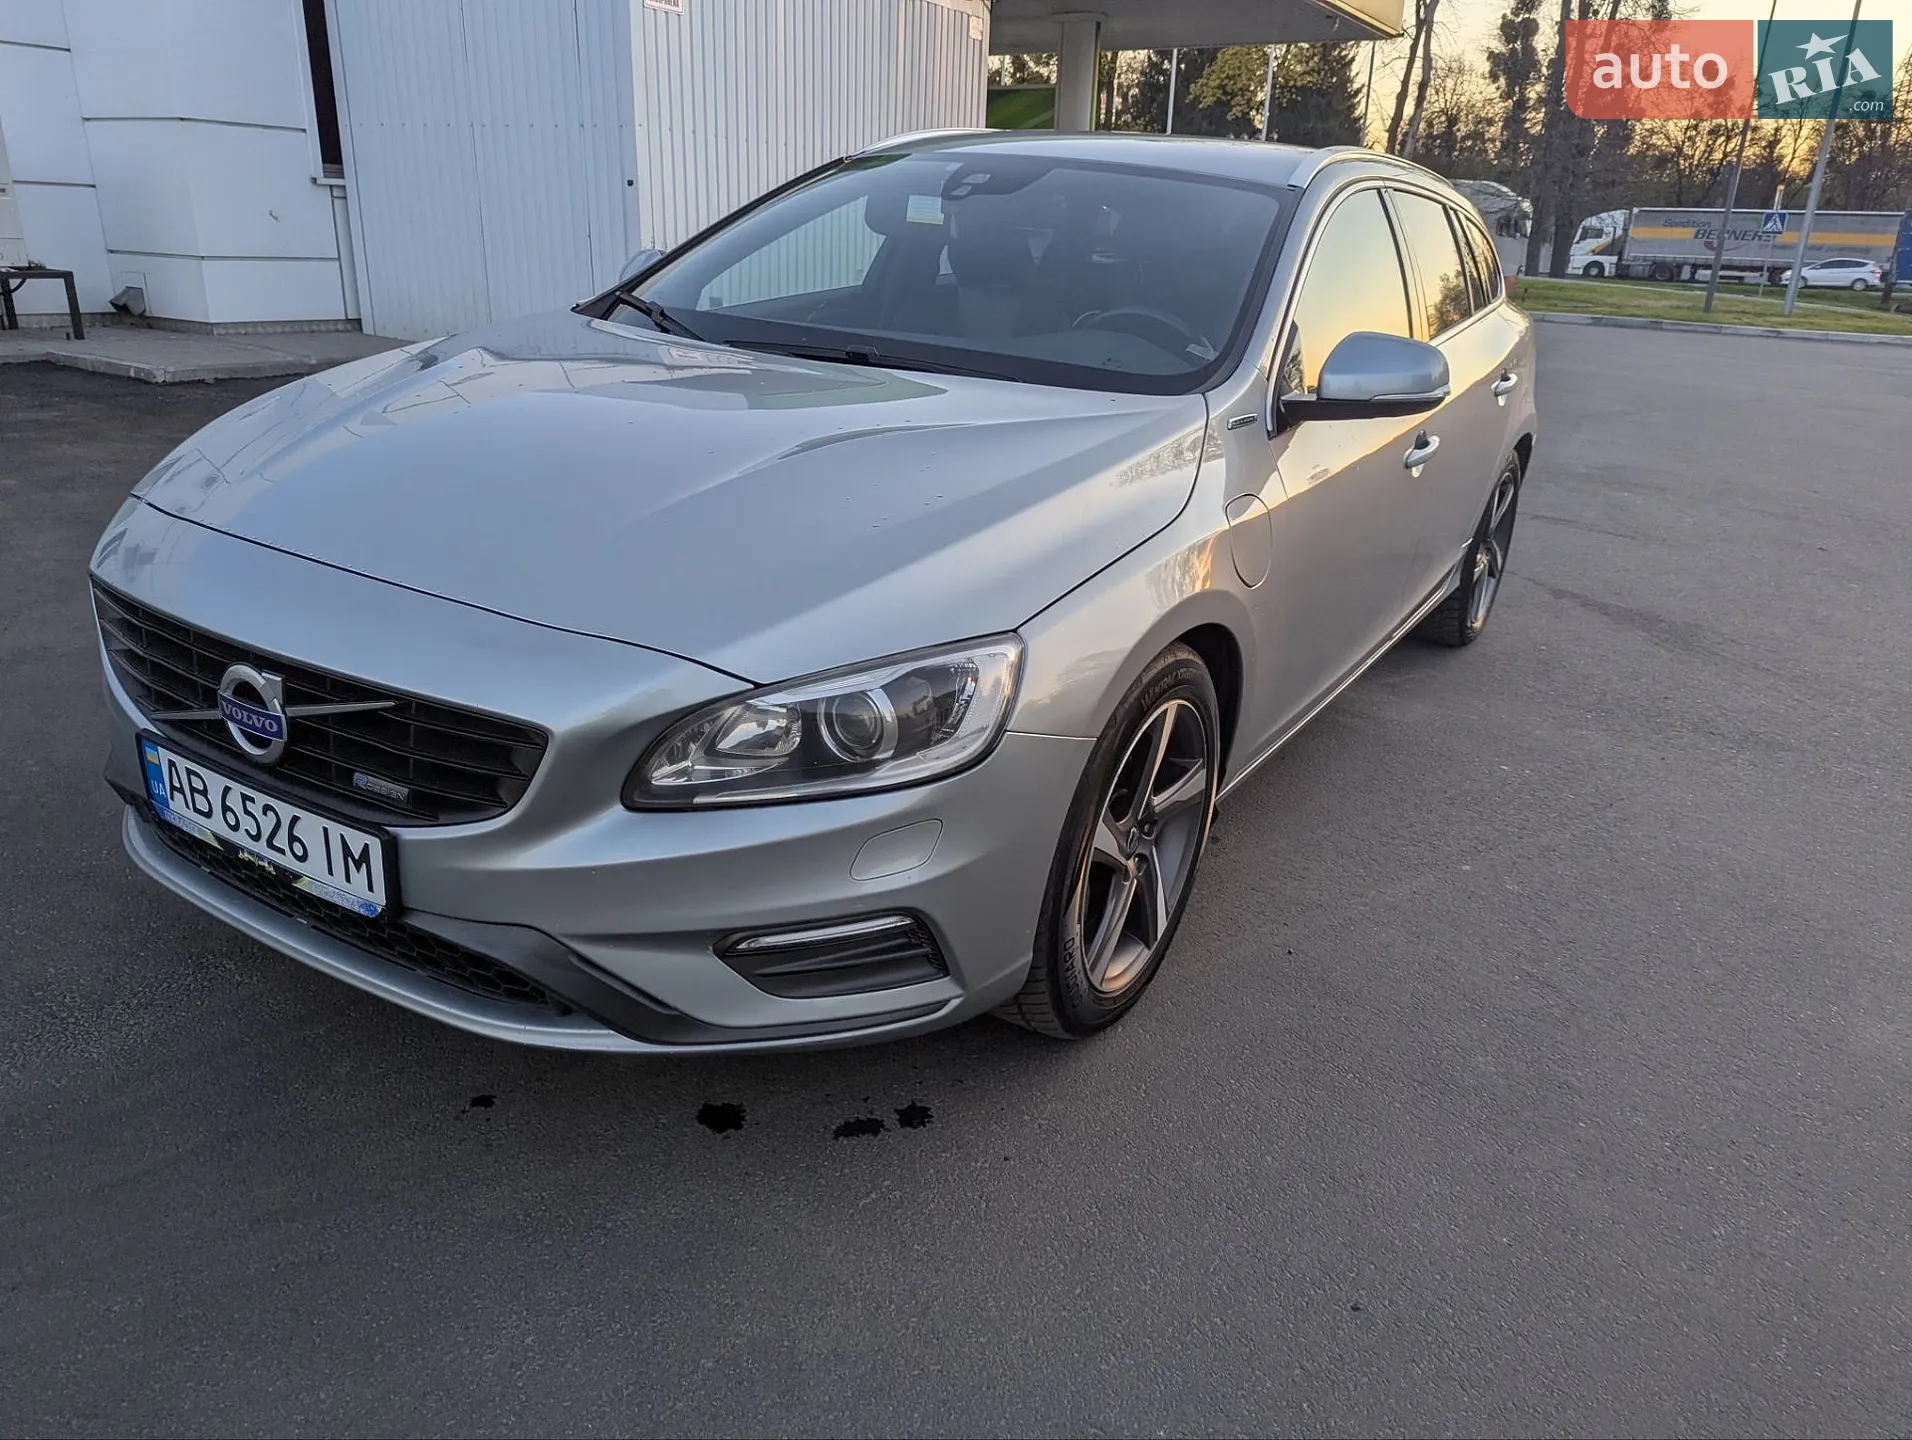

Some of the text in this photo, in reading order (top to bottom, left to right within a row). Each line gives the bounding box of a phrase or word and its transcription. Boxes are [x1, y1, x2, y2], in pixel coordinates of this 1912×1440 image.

[221, 701, 279, 732] VOLVO
[150, 780, 167, 799] UA
[167, 758, 375, 893] AB 6526 IM
